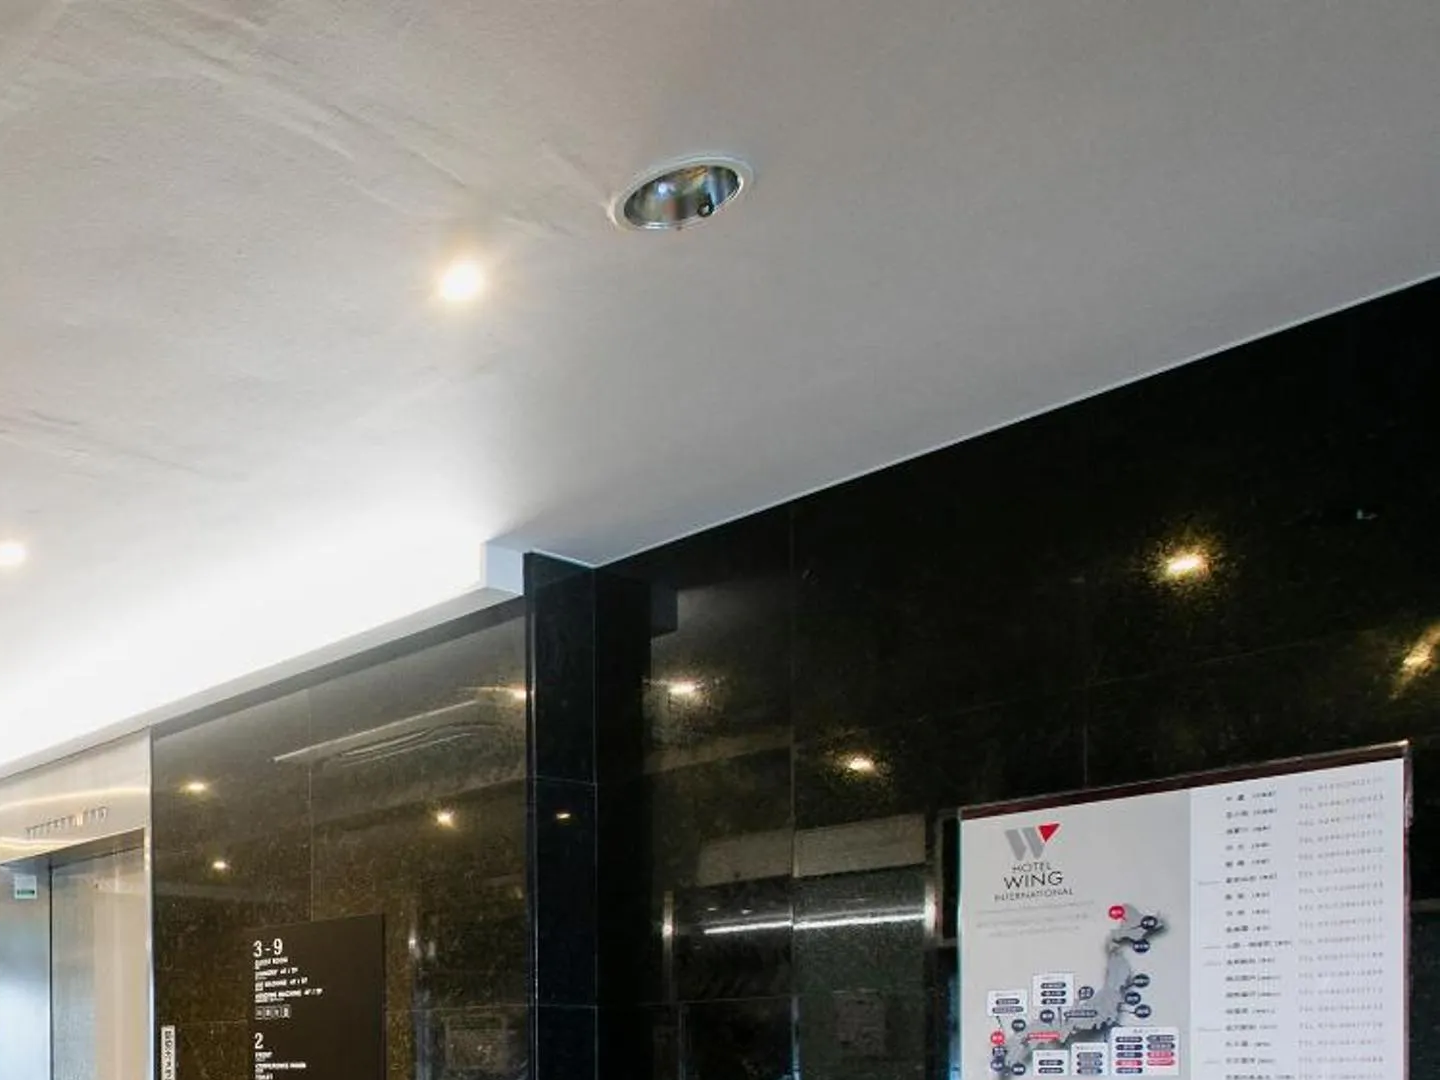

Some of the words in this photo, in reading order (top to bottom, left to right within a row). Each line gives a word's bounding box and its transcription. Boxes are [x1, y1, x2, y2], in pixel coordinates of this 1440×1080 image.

[1011, 861, 1052, 874] HOTEL
[1003, 871, 1064, 890] WING
[993, 888, 1074, 902] INTERNATIONAL
[254, 1032, 264, 1050] 2
